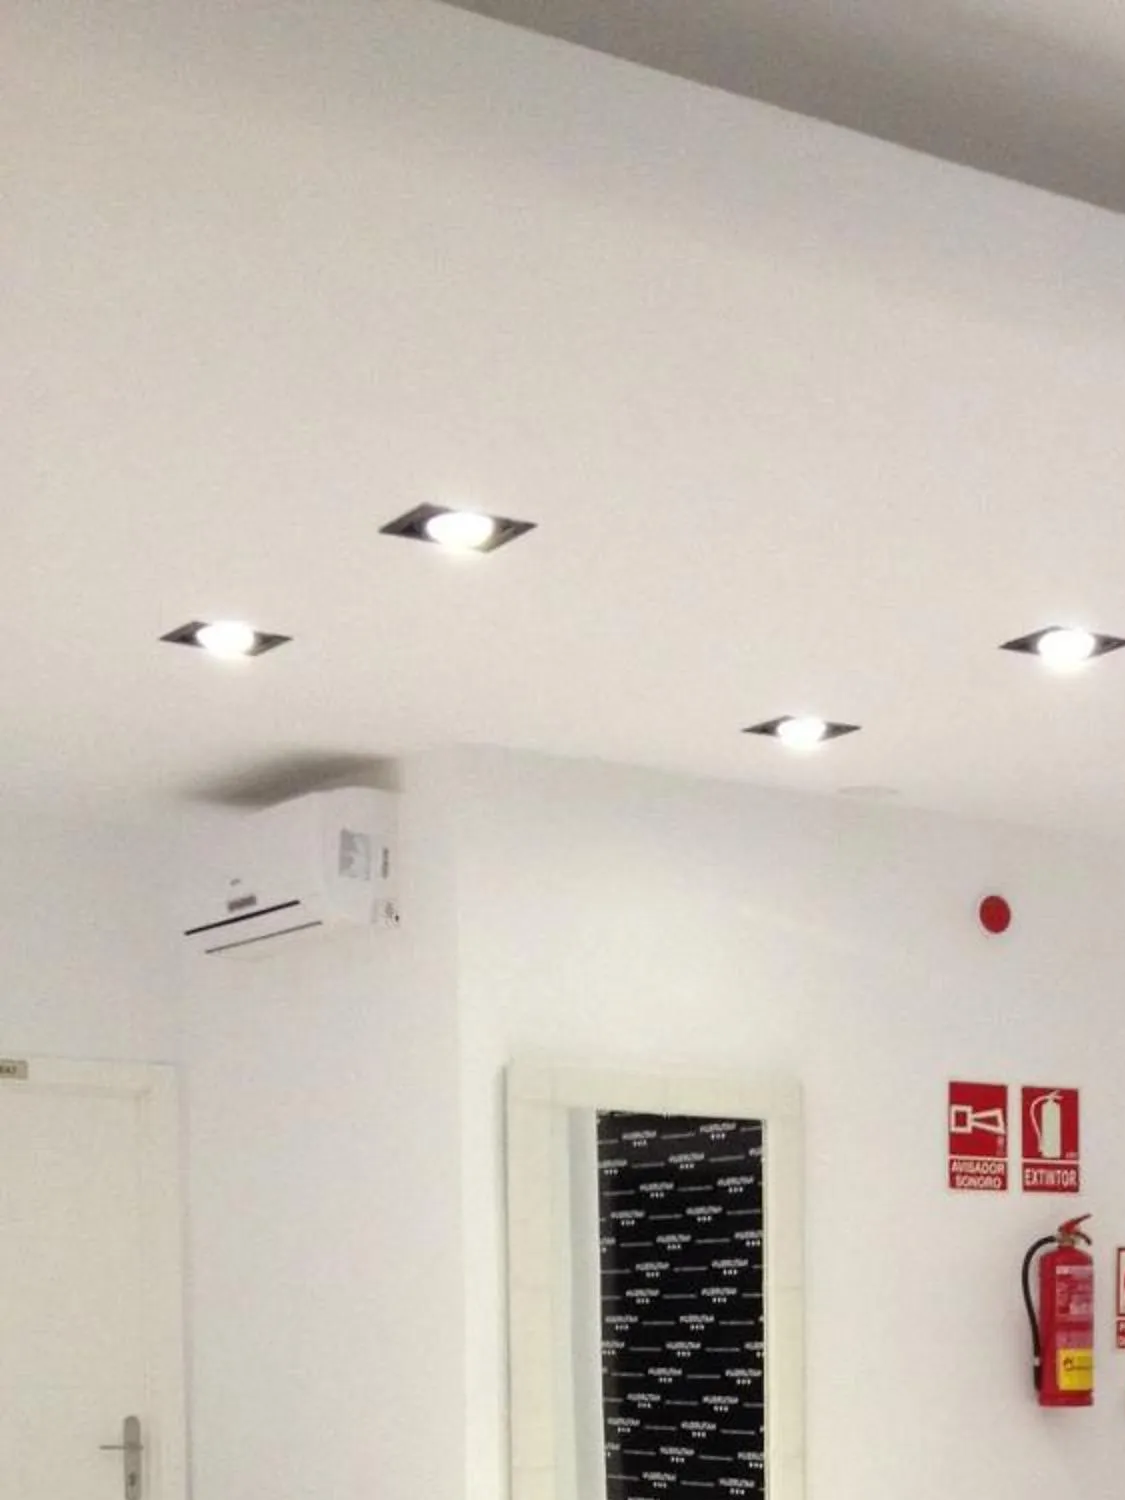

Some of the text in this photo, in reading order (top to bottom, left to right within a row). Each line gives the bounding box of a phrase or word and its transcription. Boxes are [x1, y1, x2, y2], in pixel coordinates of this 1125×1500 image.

[951, 1160, 1005, 1174] AVISADOR
[955, 1174, 1003, 1188] SONORO
[1024, 1168, 1077, 1187] EXTINTOR
